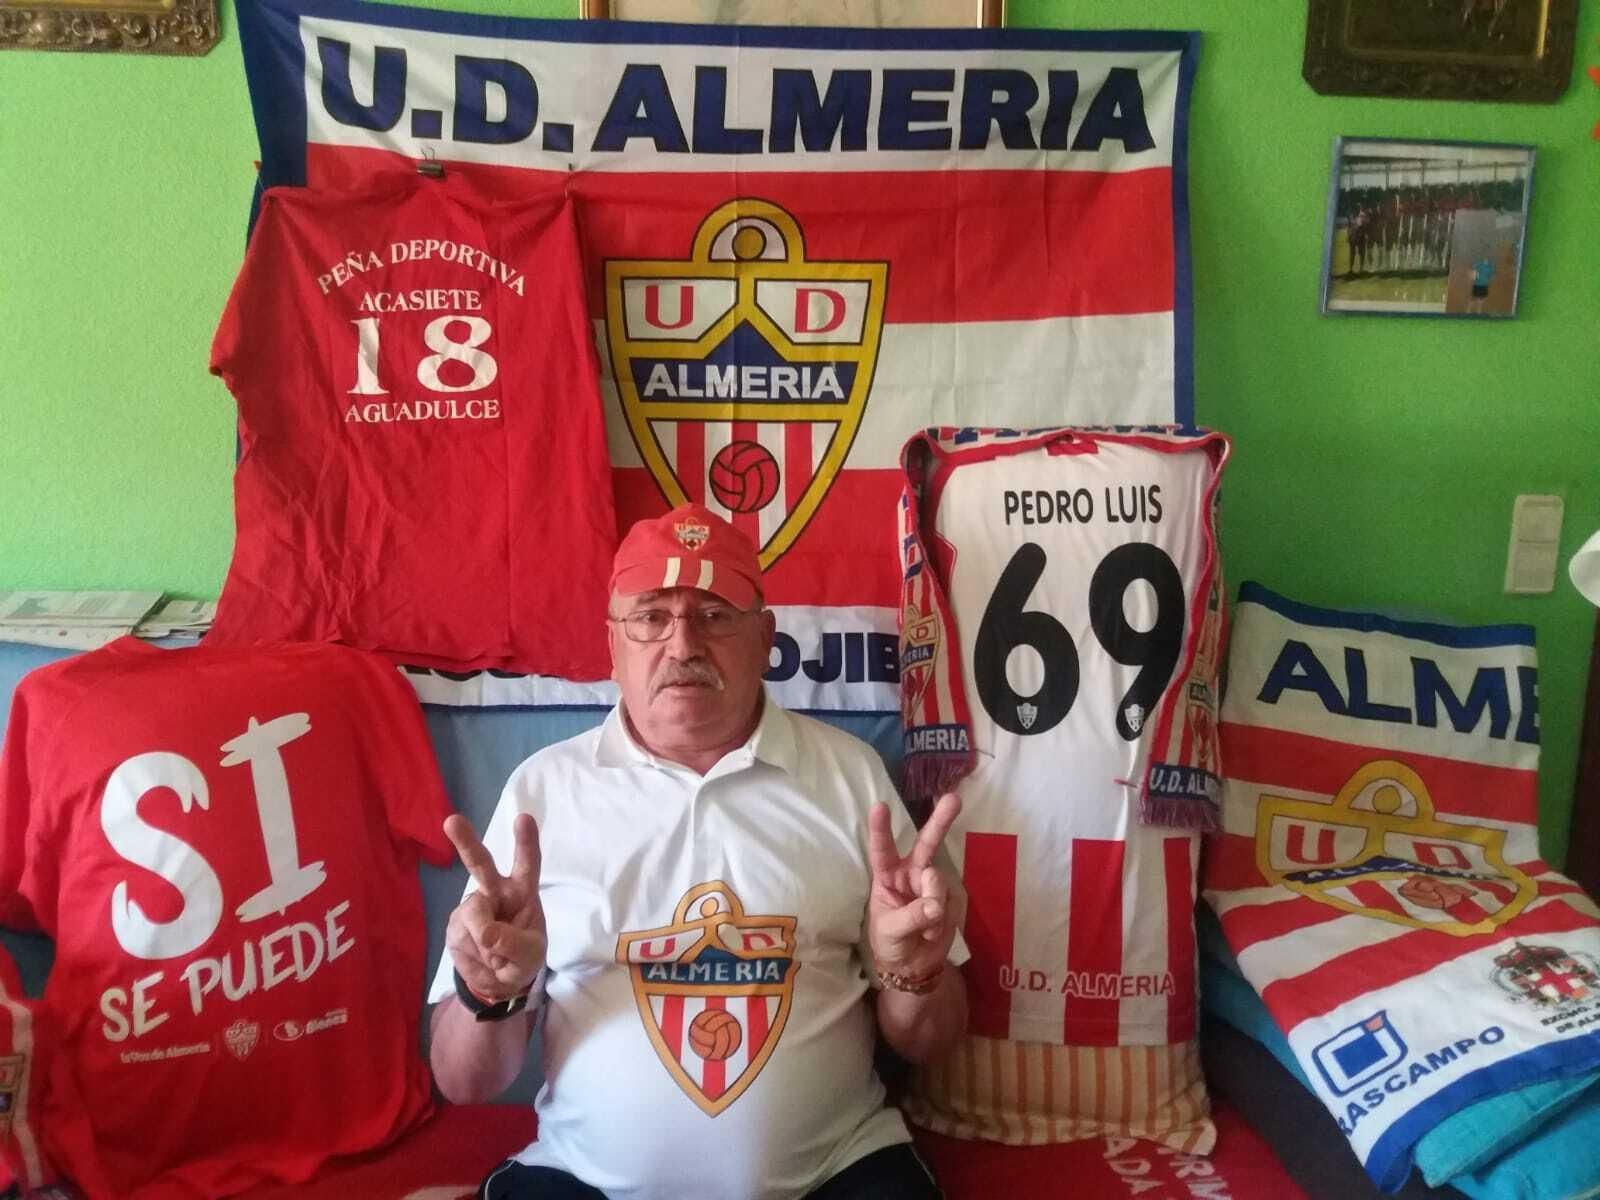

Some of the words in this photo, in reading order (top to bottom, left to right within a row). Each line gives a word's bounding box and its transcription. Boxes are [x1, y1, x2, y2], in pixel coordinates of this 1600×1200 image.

[590, 64, 1156, 154] ALMERIA
[317, 251, 383, 296] PEÑA
[391, 239, 526, 297] DEPORTIVA
[359, 289, 482, 313] ACASIETE
[644, 285, 694, 330] U
[793, 288, 846, 334] D
[644, 364, 845, 400] ALMERIA
[344, 399, 500, 423] AGUADULCE
[1004, 488, 1094, 525] PEDRO
[1105, 485, 1163, 524] LUIS
[974, 542, 1186, 742] 69
[101, 712, 327, 960] SI
[640, 937, 676, 960] U
[100, 971, 169, 1042] SE
[180, 900, 355, 1016] PUEDE
[647, 960, 781, 984] ALMERIA
[1000, 967, 1052, 993] U.D.
[1061, 972, 1175, 999] ALMERIA
